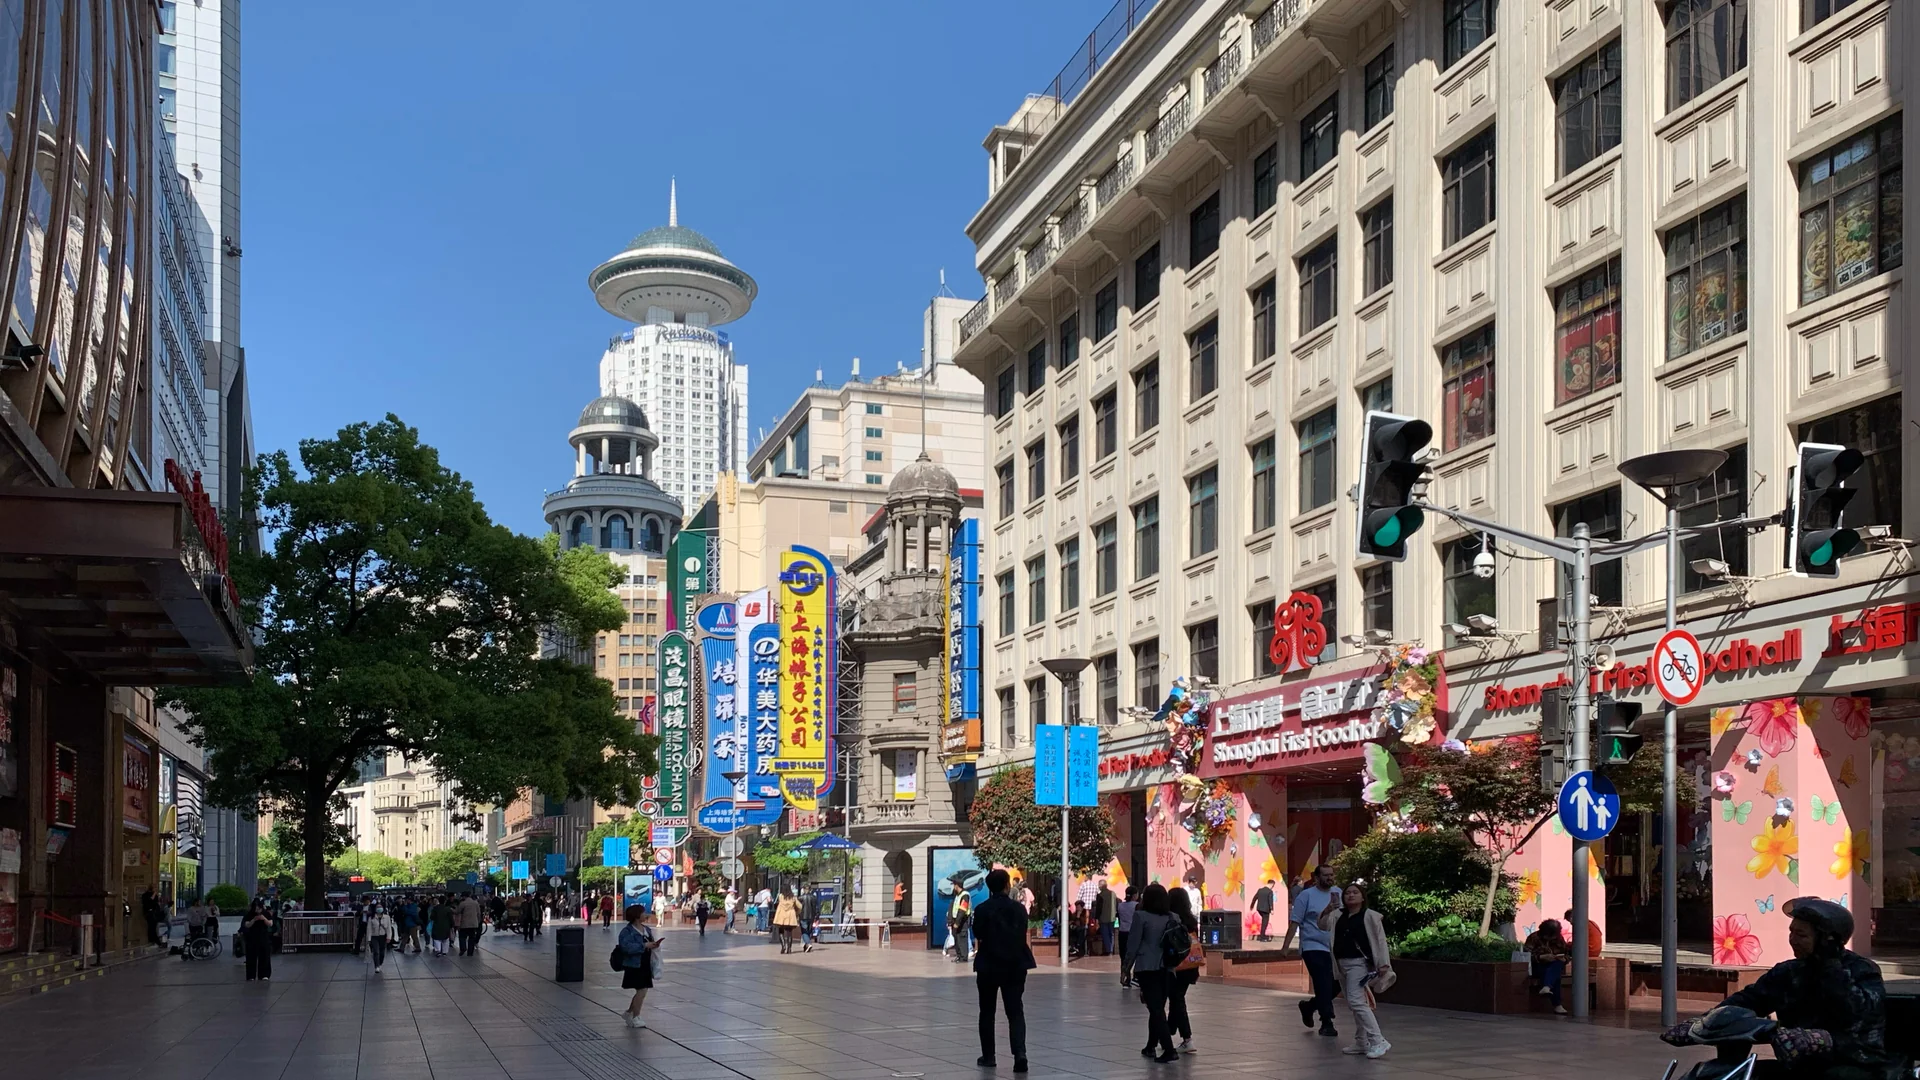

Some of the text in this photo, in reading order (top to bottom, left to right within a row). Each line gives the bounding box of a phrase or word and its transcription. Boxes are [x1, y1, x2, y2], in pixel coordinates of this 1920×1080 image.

[655, 323, 717, 347] Radisson
[662, 646, 687, 730] 茂昌眼镜
[756, 667, 778, 775] 华美大药房
[671, 731, 684, 813] MAOCHANG
[1213, 733, 1280, 763] Shanghai
[1281, 727, 1312, 752] First
